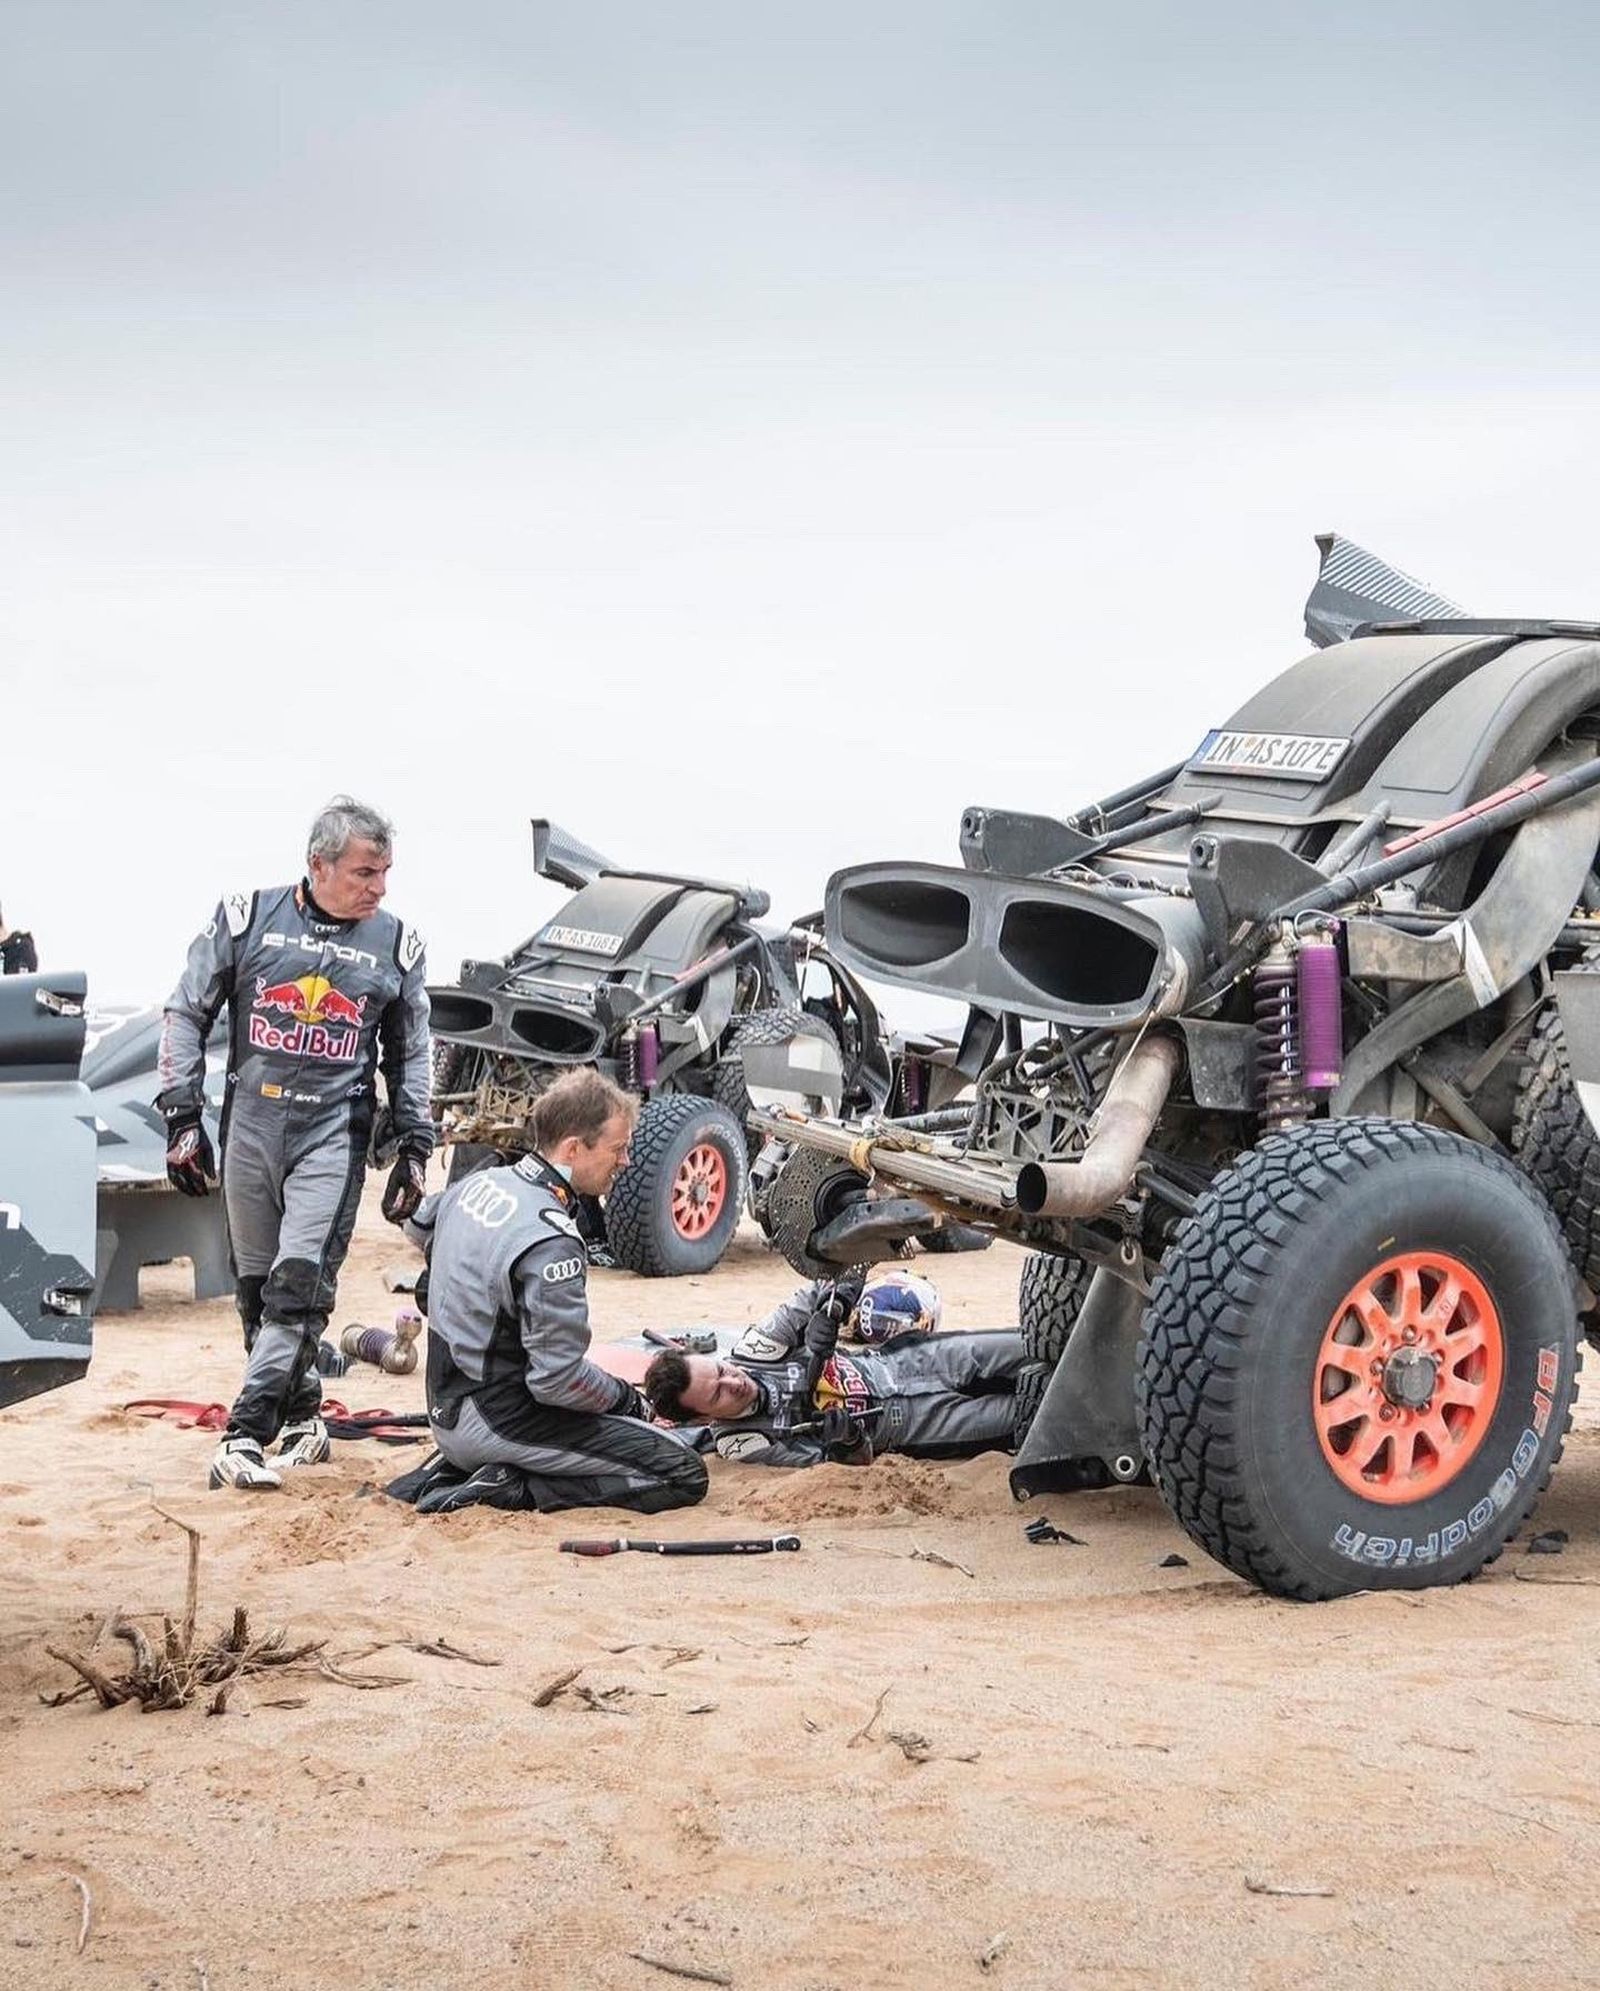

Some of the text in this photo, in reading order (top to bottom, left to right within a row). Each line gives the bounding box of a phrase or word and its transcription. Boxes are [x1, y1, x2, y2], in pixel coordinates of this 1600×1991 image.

[1207, 735, 1244, 761] IN
[547, 927, 562, 940] IN
[262, 932, 377, 969] e-tron
[249, 1012, 359, 1061] Red Bull
